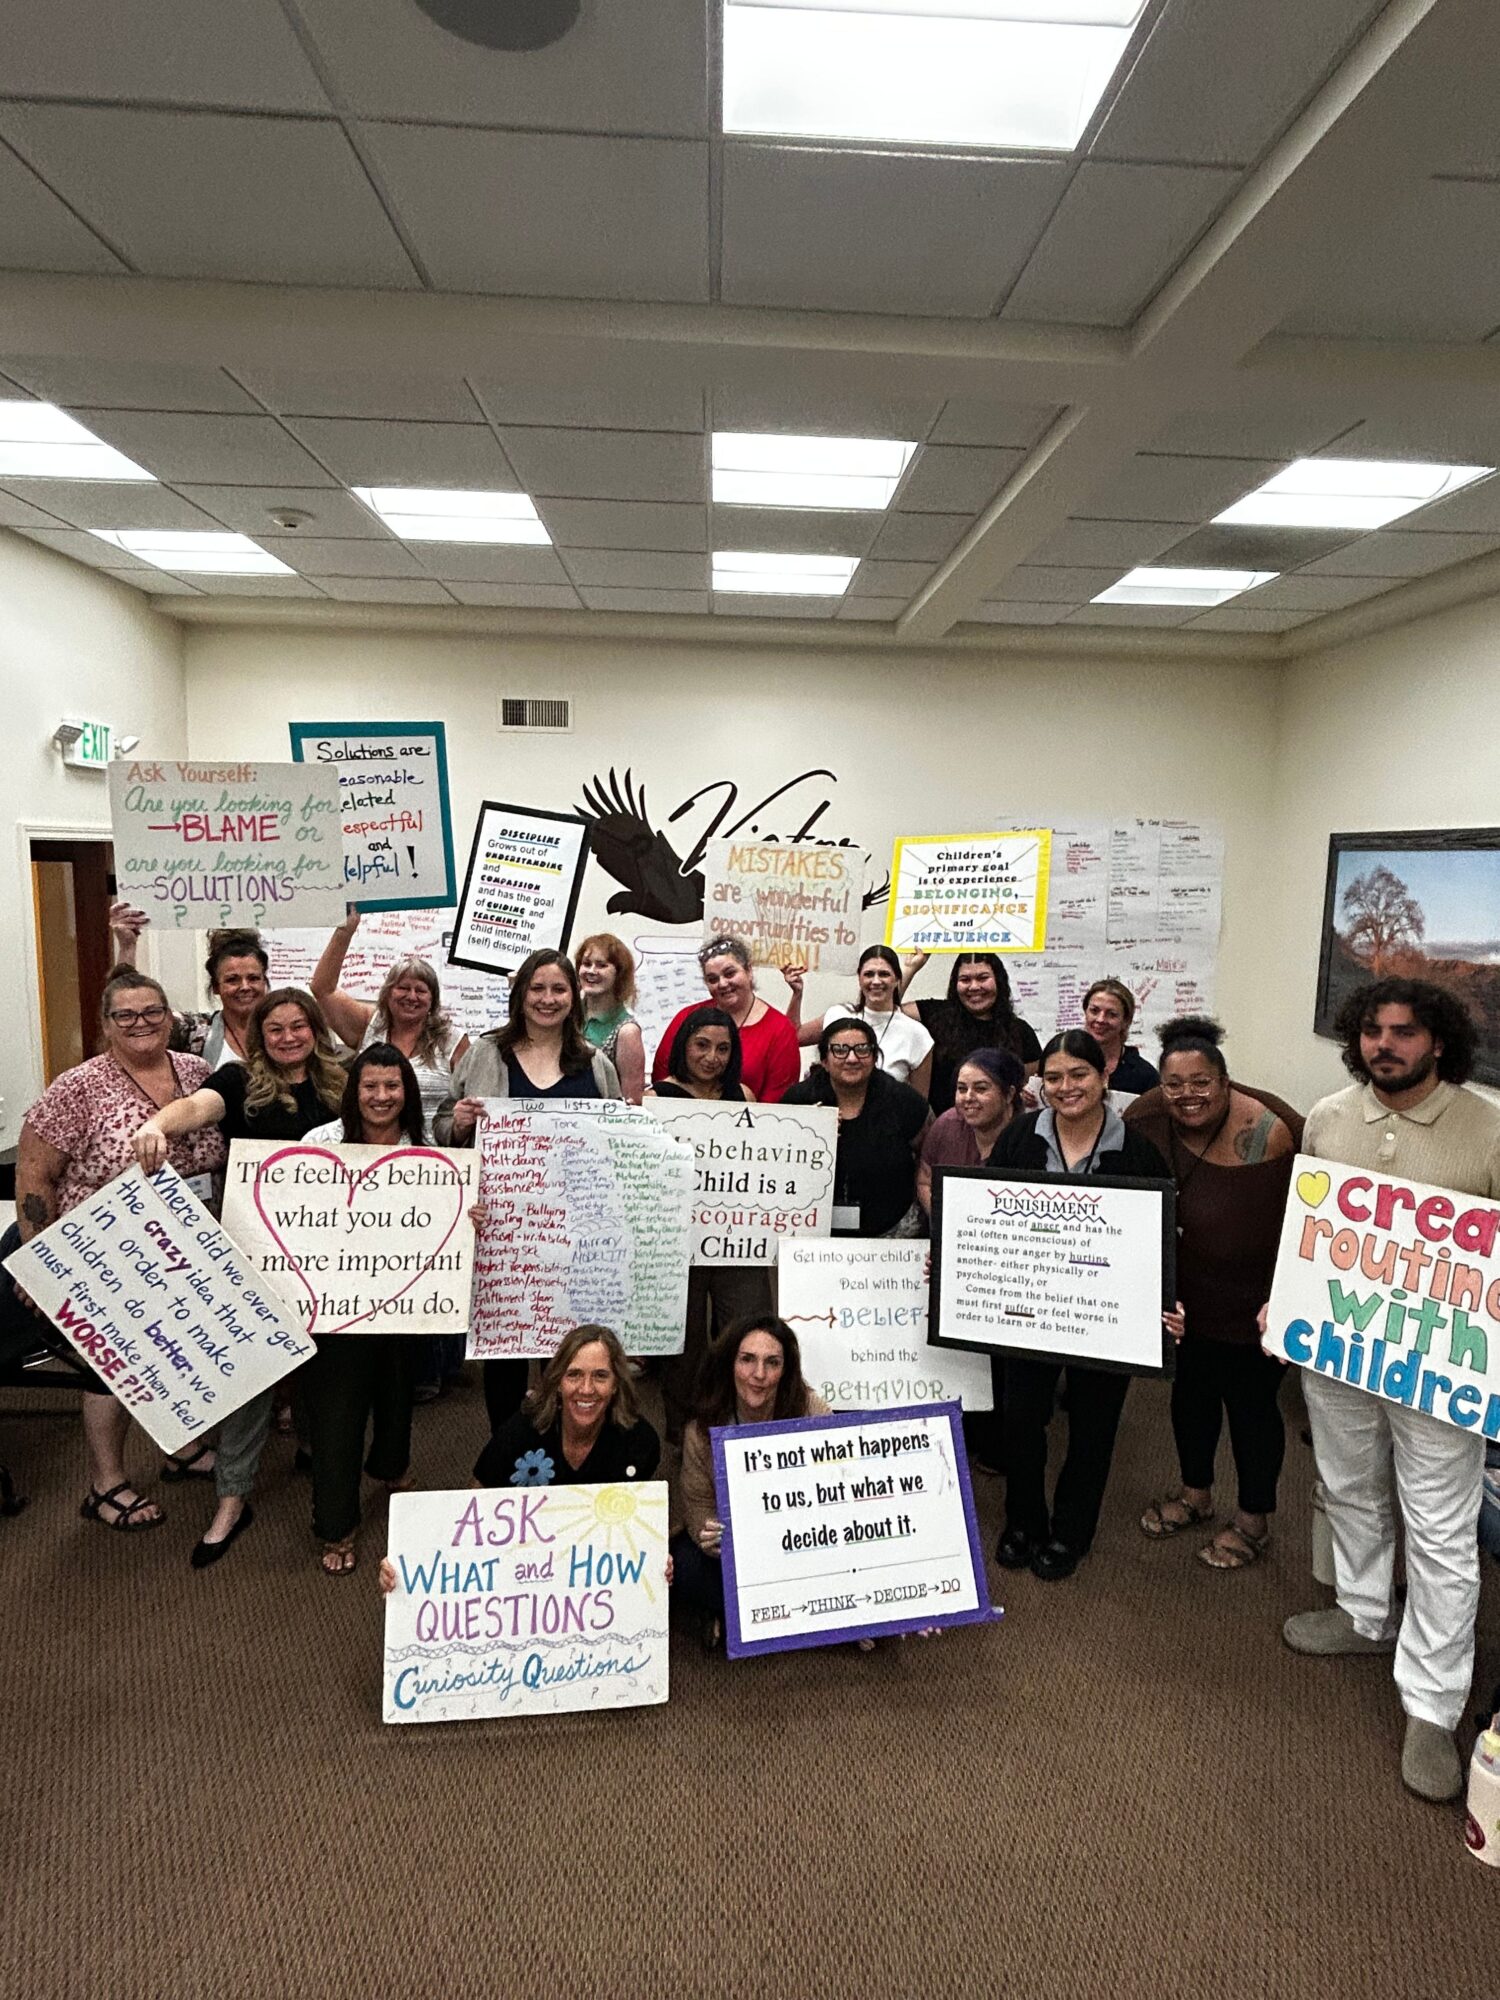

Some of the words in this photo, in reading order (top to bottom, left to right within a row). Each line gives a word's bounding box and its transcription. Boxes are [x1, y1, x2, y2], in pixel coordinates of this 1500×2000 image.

[82, 722, 110, 761] EXIT
[317, 741, 397, 761] Solutions
[126, 762, 167, 783] Ask
[176, 762, 257, 783] Yourself:
[338, 769, 424, 787] easonable
[124, 785, 164, 813] Are
[169, 797, 208, 821] you
[213, 788, 293, 824] looking
[300, 793, 338, 822] for
[340, 789, 396, 812] elated
[182, 814, 281, 843] BLAME
[295, 826, 323, 842] or
[342, 809, 423, 837] espectful
[368, 837, 392, 851] and
[487, 839, 518, 853] Grows
[519, 845, 535, 855] out
[537, 848, 548, 857] of
[499, 828, 561, 846] DISCIPLINE
[124, 855, 159, 873] are
[163, 859, 207, 878] you
[213, 850, 291, 878] looking
[291, 852, 330, 879] for
[482, 863, 501, 873] and
[484, 851, 563, 871] UNDERSTANDING
[726, 845, 844, 880] MISTAKES
[927, 864, 979, 874] primary
[982, 862, 1010, 872] goal
[936, 850, 1003, 861] Children's
[153, 875, 295, 903] SOLUTIONS
[480, 874, 541, 891] COMPASSION
[918, 877, 929, 885] is
[933, 875, 945, 885] to
[949, 875, 1018, 885] experience
[712, 882, 742, 903] are
[755, 881, 850, 913] wonderful
[913, 887, 1020, 900] BELONGING,
[902, 903, 1028, 916] SIGNIFICANCE
[710, 915, 830, 944] opportunities
[834, 921, 856, 945] to
[953, 919, 974, 928] and
[913, 931, 1012, 943] INFLUENCE
[512, 1098, 545, 1112] Two
[479, 1114, 532, 1133] Challenges
[734, 1107, 755, 1129] A
[676, 1137, 825, 1171] sbehaving
[237, 1160, 285, 1184] The
[293, 1161, 380, 1191] feeling
[387, 1162, 472, 1186] behind
[758, 1173, 776, 1194] is
[785, 1179, 797, 1195] a
[275, 1204, 339, 1228] what
[345, 1210, 392, 1234] you
[400, 1204, 432, 1228] do
[994, 1197, 1099, 1216] PUNISHMENT
[1337, 1176, 1500, 1258] crea
[691, 1207, 818, 1233] couraged
[966, 1215, 997, 1227] Grows
[999, 1218, 1016, 1228] out
[1018, 1219, 1029, 1228] of
[1031, 1221, 1061, 1233] anger
[1063, 1223, 1082, 1233] and
[1085, 1223, 1103, 1234] has
[1106, 1225, 1123, 1236] the
[700, 1235, 768, 1259] Child
[957, 1228, 977, 1239] goal
[980, 1229, 1009, 1241] (often
[1011, 1233, 1077, 1248] unconscious)
[1080, 1237, 1092, 1248] of
[116, 1178, 145, 1216] the
[143, 1219, 192, 1273] crazy
[186, 1268, 215, 1305] idea
[214, 1302, 254, 1345] that
[260, 1254, 330, 1272] more
[338, 1248, 463, 1278] important
[793, 1250, 815, 1263] Get
[819, 1250, 844, 1263] into
[847, 1253, 878, 1266] your
[880, 1249, 921, 1263] child's
[957, 1242, 1000, 1255] releasing
[1002, 1247, 1020, 1256] our
[1022, 1248, 1051, 1260] anger
[1054, 1250, 1067, 1262] by
[1069, 1252, 1110, 1265] hurting
[90, 1200, 117, 1232] in
[119, 1237, 169, 1292] order
[167, 1296, 191, 1321] to
[188, 1323, 237, 1378] make
[196, 1228, 232, 1262] did
[222, 1260, 245, 1286] we
[243, 1289, 279, 1325] ever
[266, 1330, 311, 1357] get
[840, 1278, 869, 1291] Deal
[873, 1278, 899, 1291] with
[902, 1278, 921, 1291] the
[61, 1220, 123, 1294] children
[124, 1298, 145, 1319] do
[144, 1319, 194, 1379] better,
[190, 1375, 217, 1404] we
[296, 1292, 361, 1316] what
[368, 1298, 414, 1321] you
[422, 1291, 460, 1315] do.
[840, 1306, 925, 1329] BELIEF
[31, 1238, 72, 1280] must
[72, 1280, 107, 1318] first
[101, 1321, 142, 1366] make
[139, 1364, 170, 1401] them
[171, 1399, 206, 1432] feel
[54, 1297, 130, 1381] WORSE
[1328, 1279, 1489, 1375] with
[851, 1348, 895, 1362] behind
[899, 1348, 919, 1362] the
[821, 1378, 951, 1403] BEHAVIOR.
[744, 1449, 773, 1473] It's
[777, 1446, 806, 1468] not
[811, 1440, 855, 1464] what
[858, 1433, 931, 1459] happens
[762, 1491, 782, 1512] to
[786, 1490, 812, 1508] us,
[815, 1483, 846, 1505] but
[851, 1475, 895, 1500] what
[900, 1474, 924, 1493] we
[451, 1494, 556, 1547] ASK
[782, 1524, 839, 1551] decide
[843, 1517, 894, 1543] about
[897, 1514, 917, 1536] it.
[398, 1550, 500, 1595] WHAT
[514, 1551, 555, 1581] and
[568, 1544, 647, 1588] HOW
[751, 1604, 791, 1624] FEEL
[807, 1594, 857, 1615] THINK
[873, 1582, 928, 1604] DECIDE
[940, 1578, 961, 1595] DO
[415, 1589, 616, 1643] QUESTIONS
[393, 1657, 518, 1710] Curiosity
[522, 1652, 651, 1690] Questions
